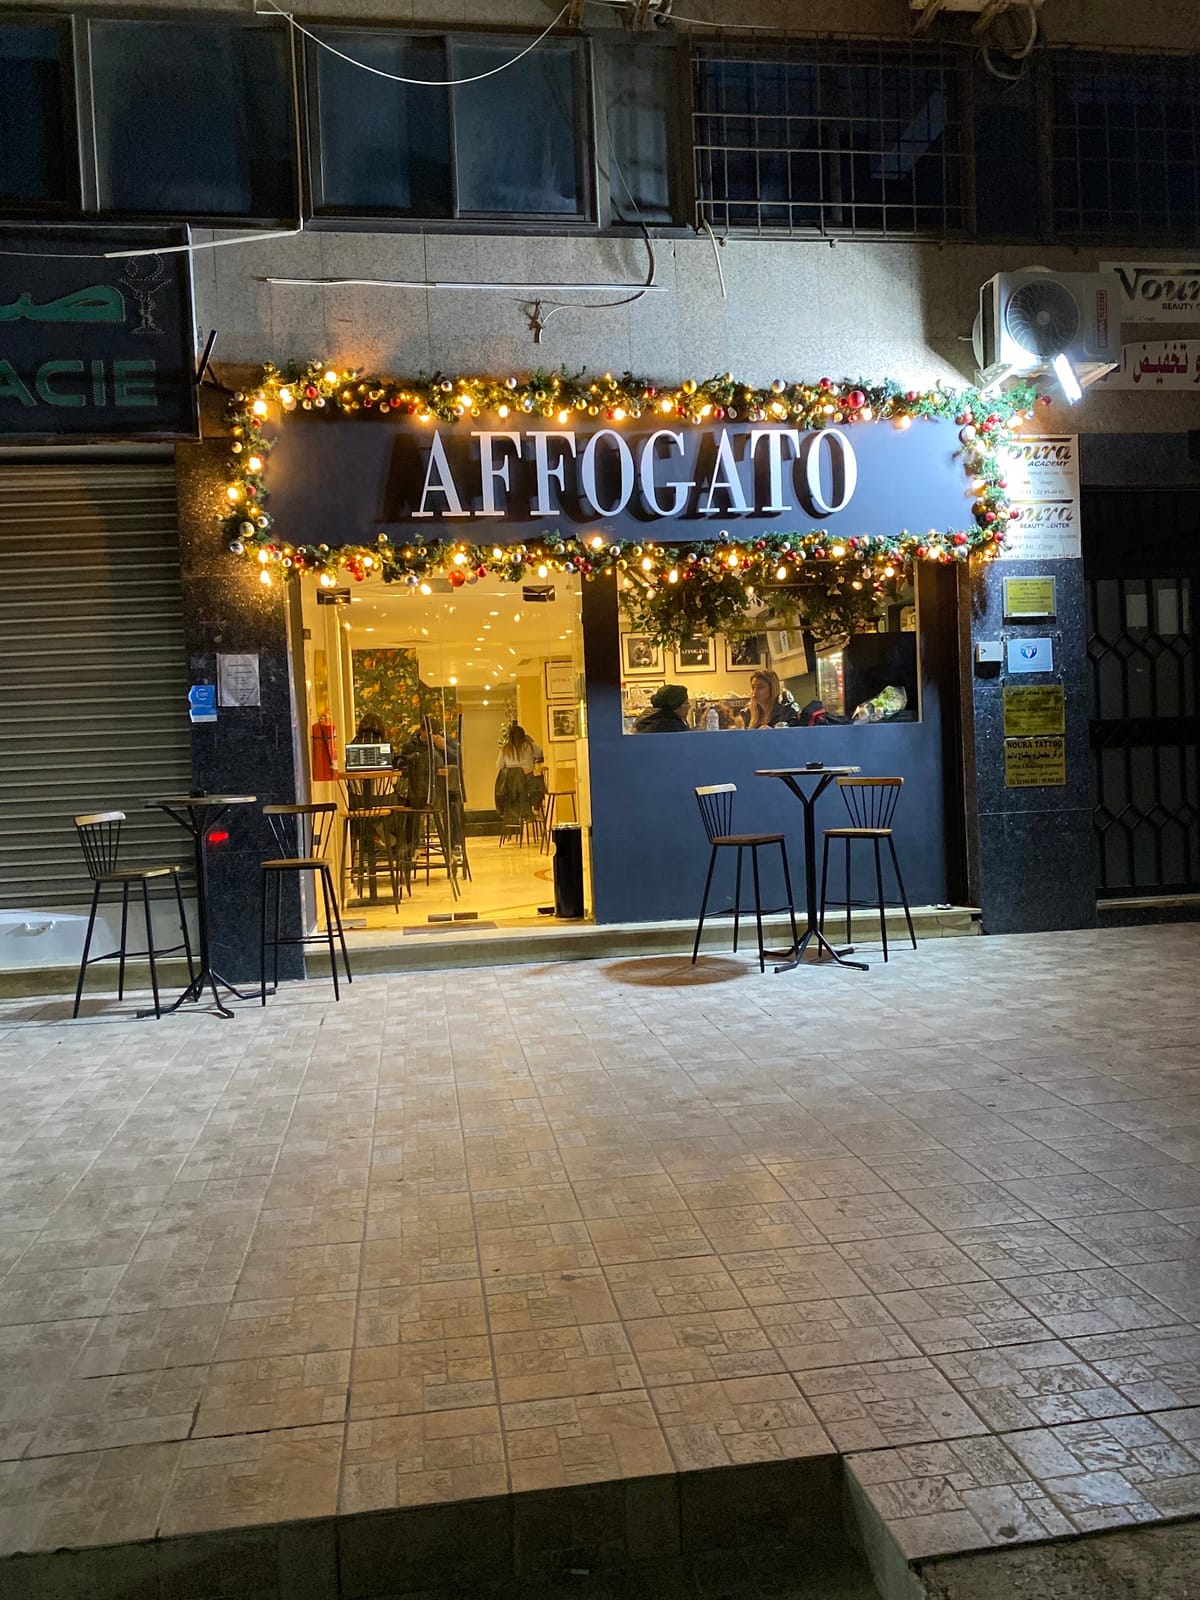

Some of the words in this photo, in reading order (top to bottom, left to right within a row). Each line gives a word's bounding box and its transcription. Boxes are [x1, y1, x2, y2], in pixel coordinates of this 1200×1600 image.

[1162, 303, 1193, 311] BEAUTY
[1132, 343, 1188, 384] تخفيض
[1008, 445, 1072, 460] oura
[411, 428, 857, 517] AFFOGATO
[1007, 741, 1033, 749] NOURA
[1035, 740, 1063, 748] TATTOO
